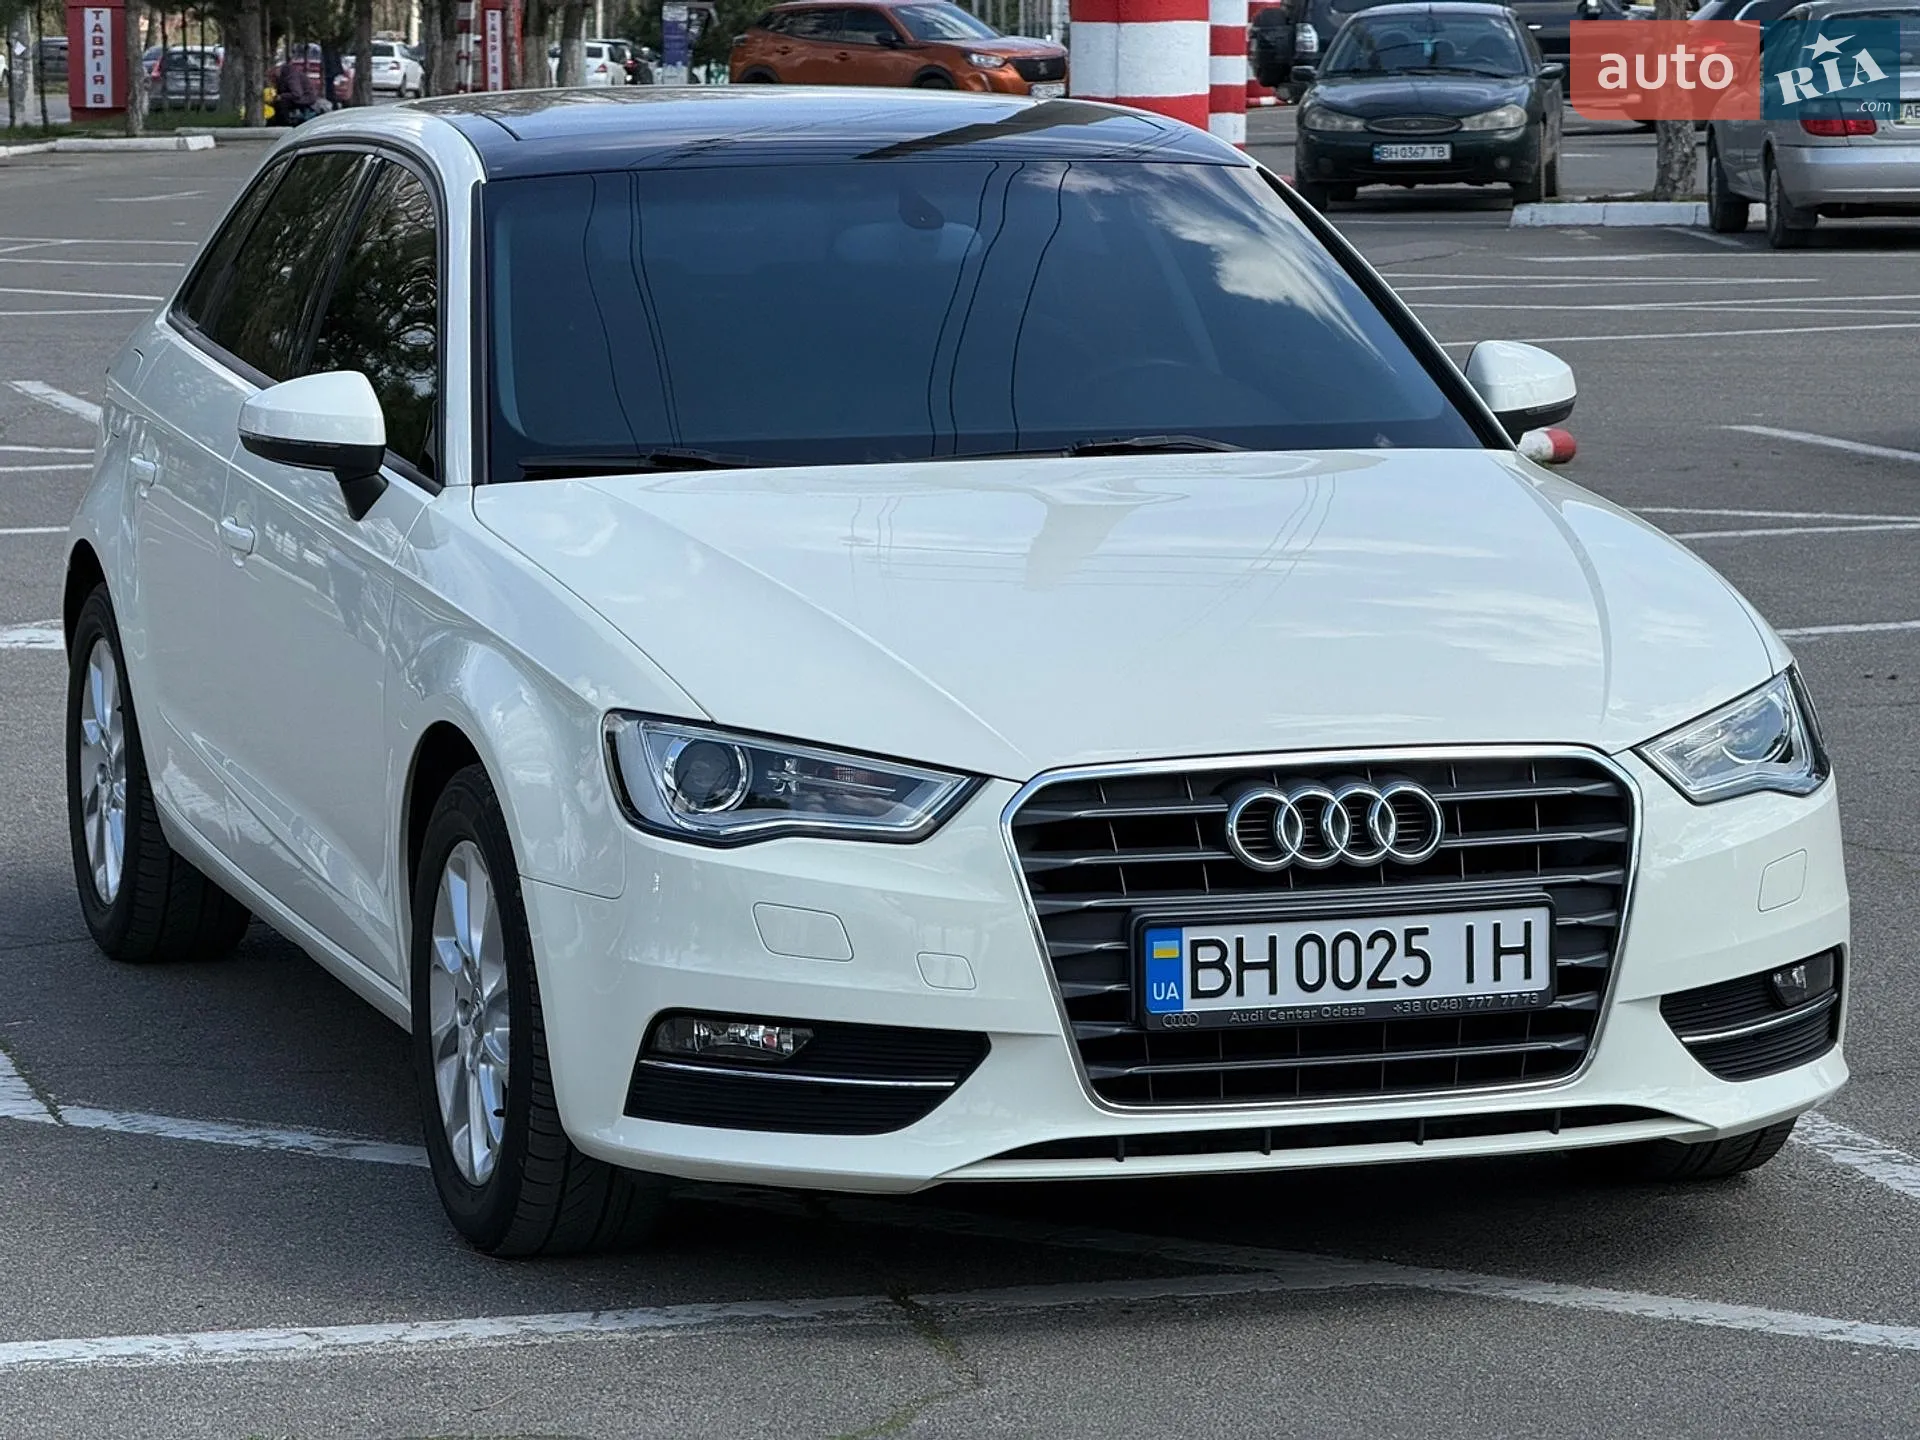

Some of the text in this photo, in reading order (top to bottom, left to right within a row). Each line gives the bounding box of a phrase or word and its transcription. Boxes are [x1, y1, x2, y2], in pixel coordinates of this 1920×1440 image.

[92, 10, 105, 85] ТАВРІЯ
[1382, 147, 1398, 158] BH
[1431, 146, 1446, 158] TB
[1189, 920, 1533, 999] BH 0025 IH
[1152, 982, 1180, 1001] UA
[1229, 1010, 1263, 1022] Audi
[1321, 1006, 1366, 1018] Odesa
[1467, 996, 1494, 1008] 777
